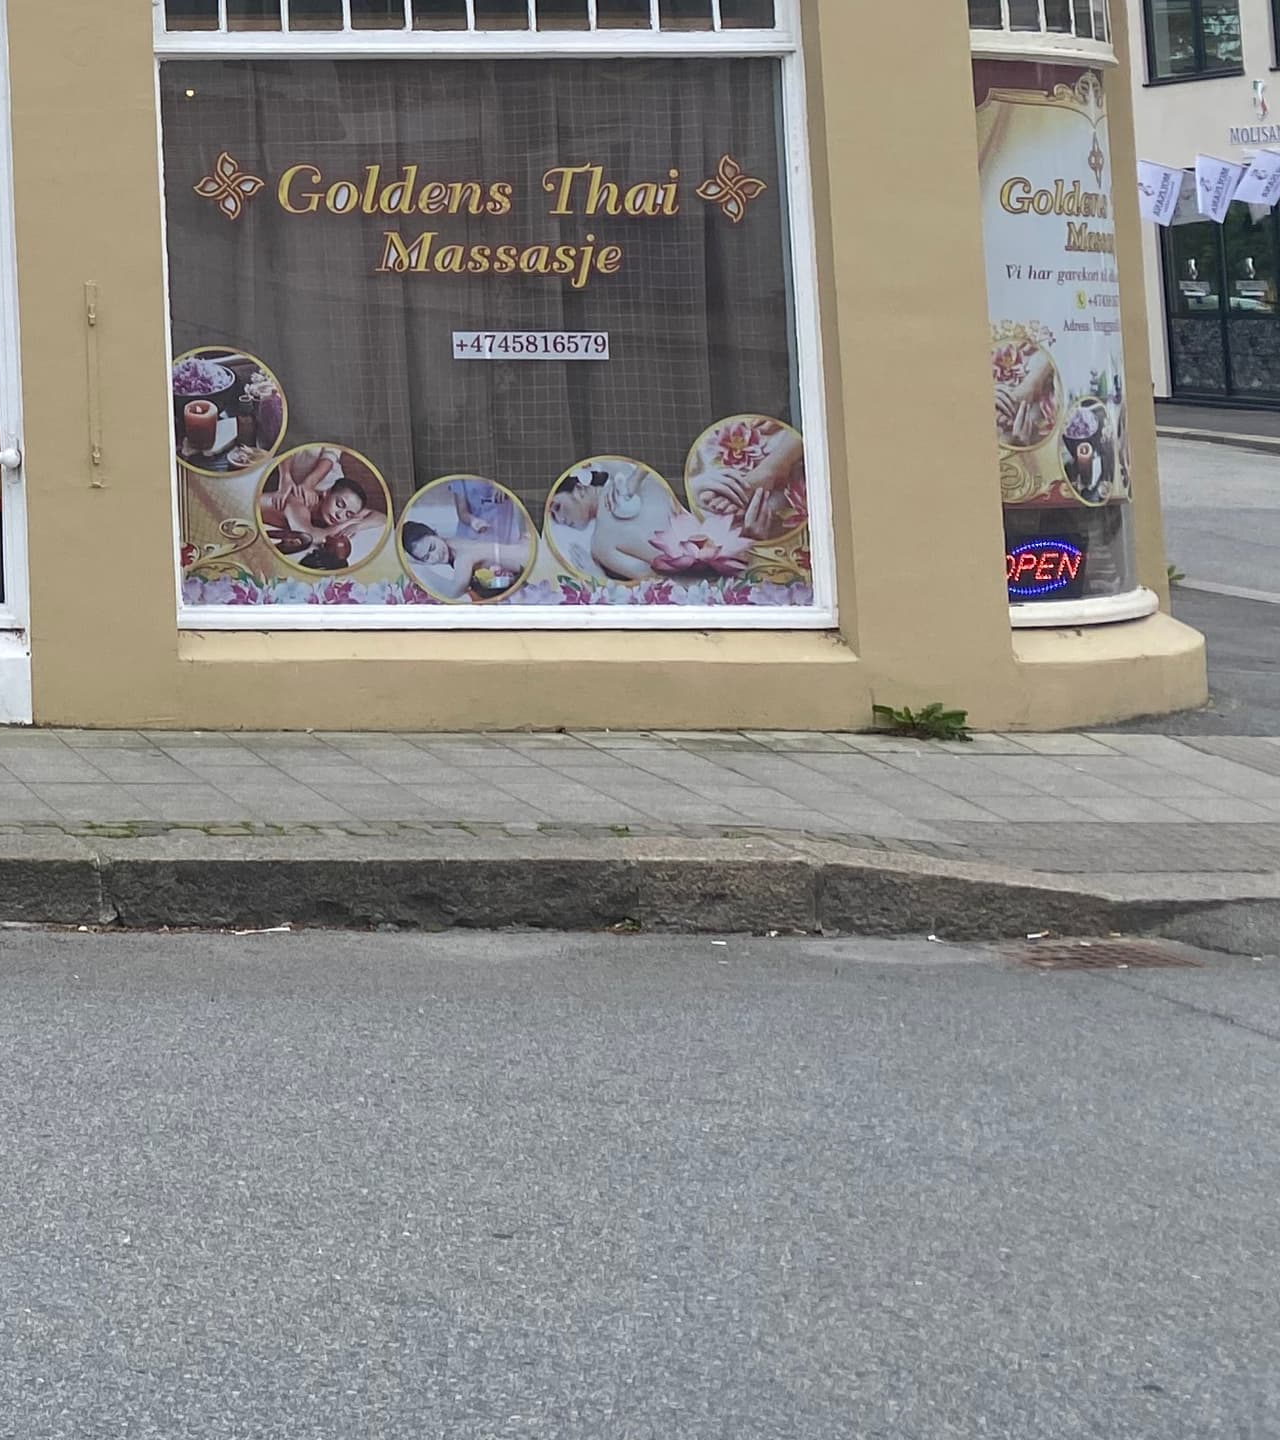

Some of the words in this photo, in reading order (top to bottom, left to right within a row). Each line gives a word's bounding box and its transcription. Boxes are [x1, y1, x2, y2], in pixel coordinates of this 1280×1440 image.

[278, 164, 513, 216] Goldens
[541, 162, 679, 216] Thai
[376, 231, 622, 288] Massasje
[1028, 265, 1053, 281] har
[454, 334, 608, 355] +4745816579
